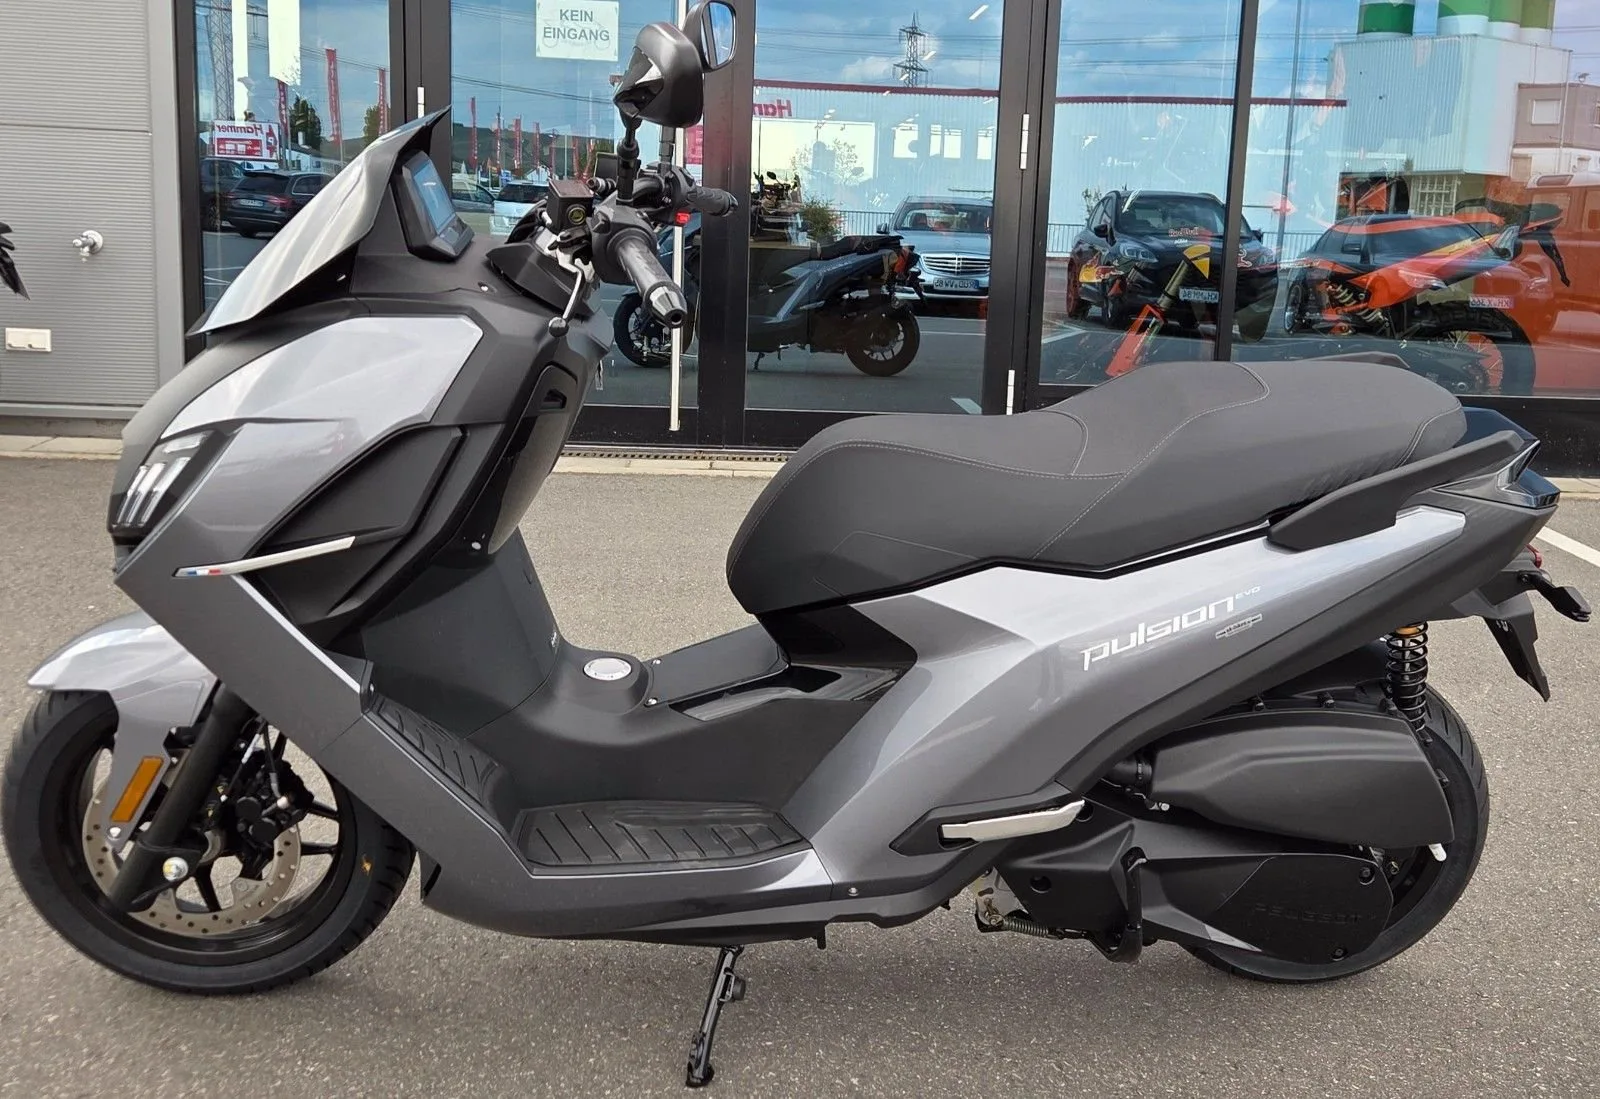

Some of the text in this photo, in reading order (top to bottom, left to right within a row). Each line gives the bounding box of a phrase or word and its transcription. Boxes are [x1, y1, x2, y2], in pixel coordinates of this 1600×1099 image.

[559, 9, 593, 22] KEIN
[543, 26, 610, 41] EINGANG
[1080, 595, 1235, 671] pulsion
[1236, 585, 1262, 599] EVO
